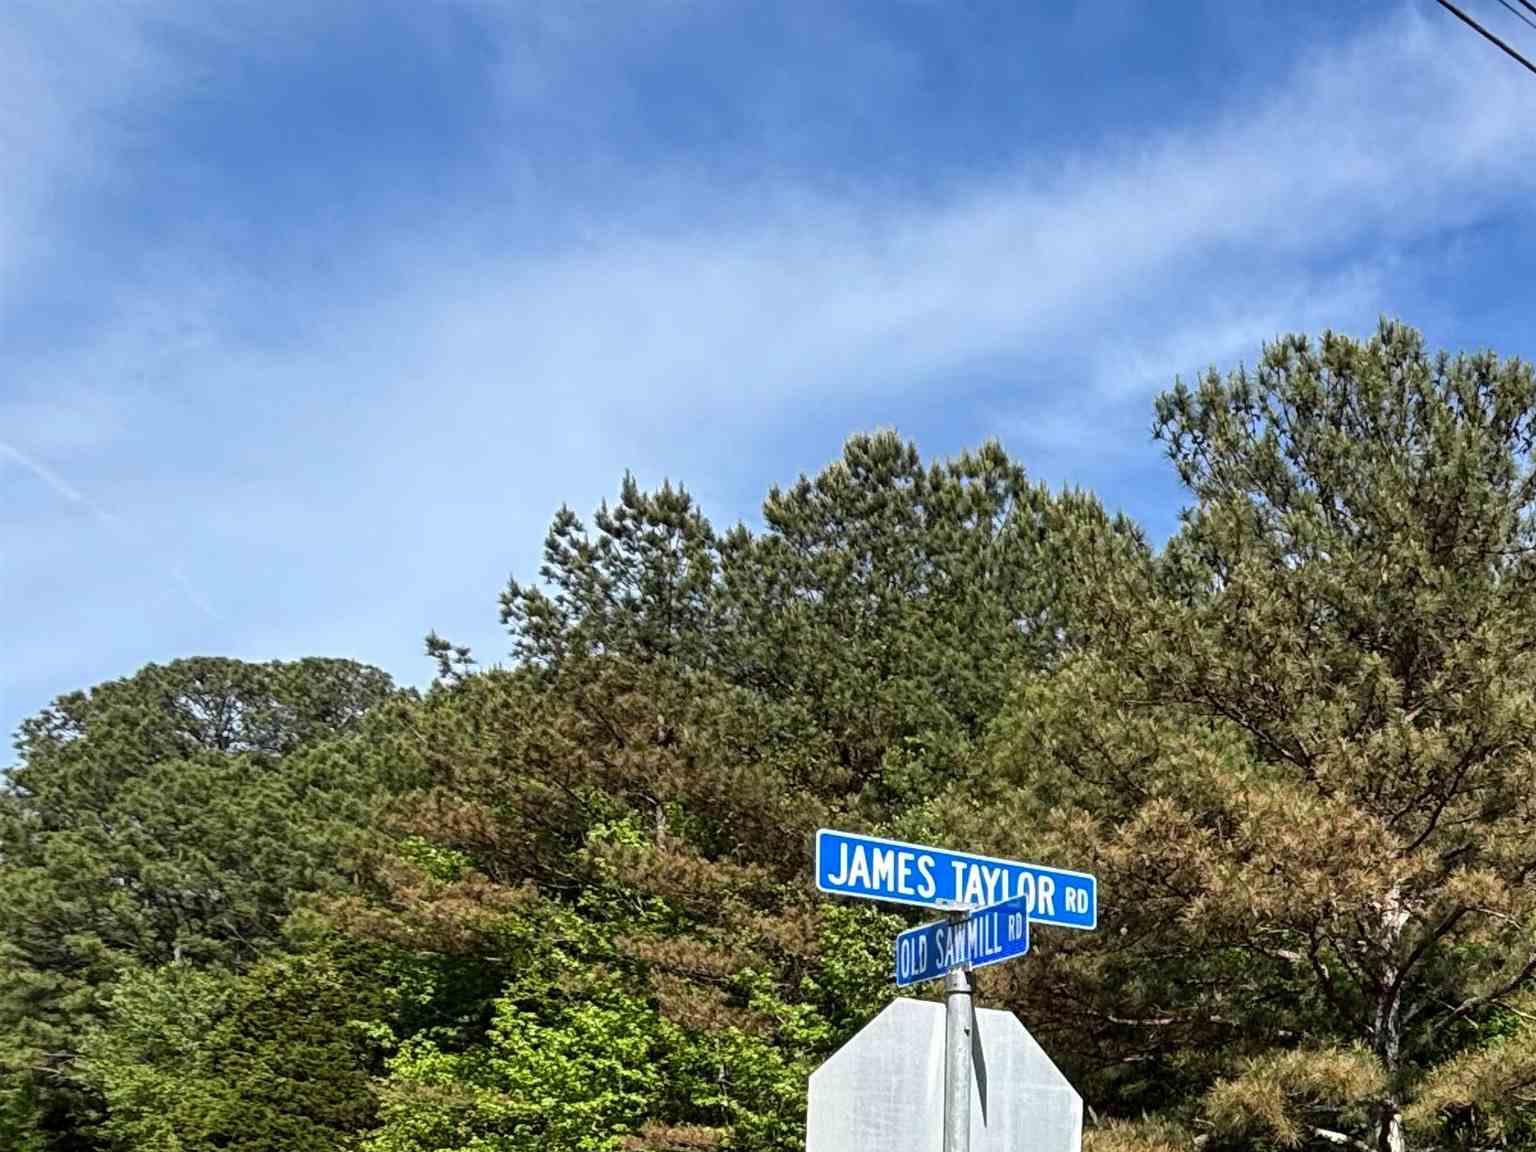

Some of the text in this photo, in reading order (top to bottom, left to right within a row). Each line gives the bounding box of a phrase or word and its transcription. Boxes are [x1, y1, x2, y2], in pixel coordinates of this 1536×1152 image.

[828, 842, 1089, 916] JAMES TAYLOR RD
[900, 912, 1023, 978] OLD SAWMILL RD
